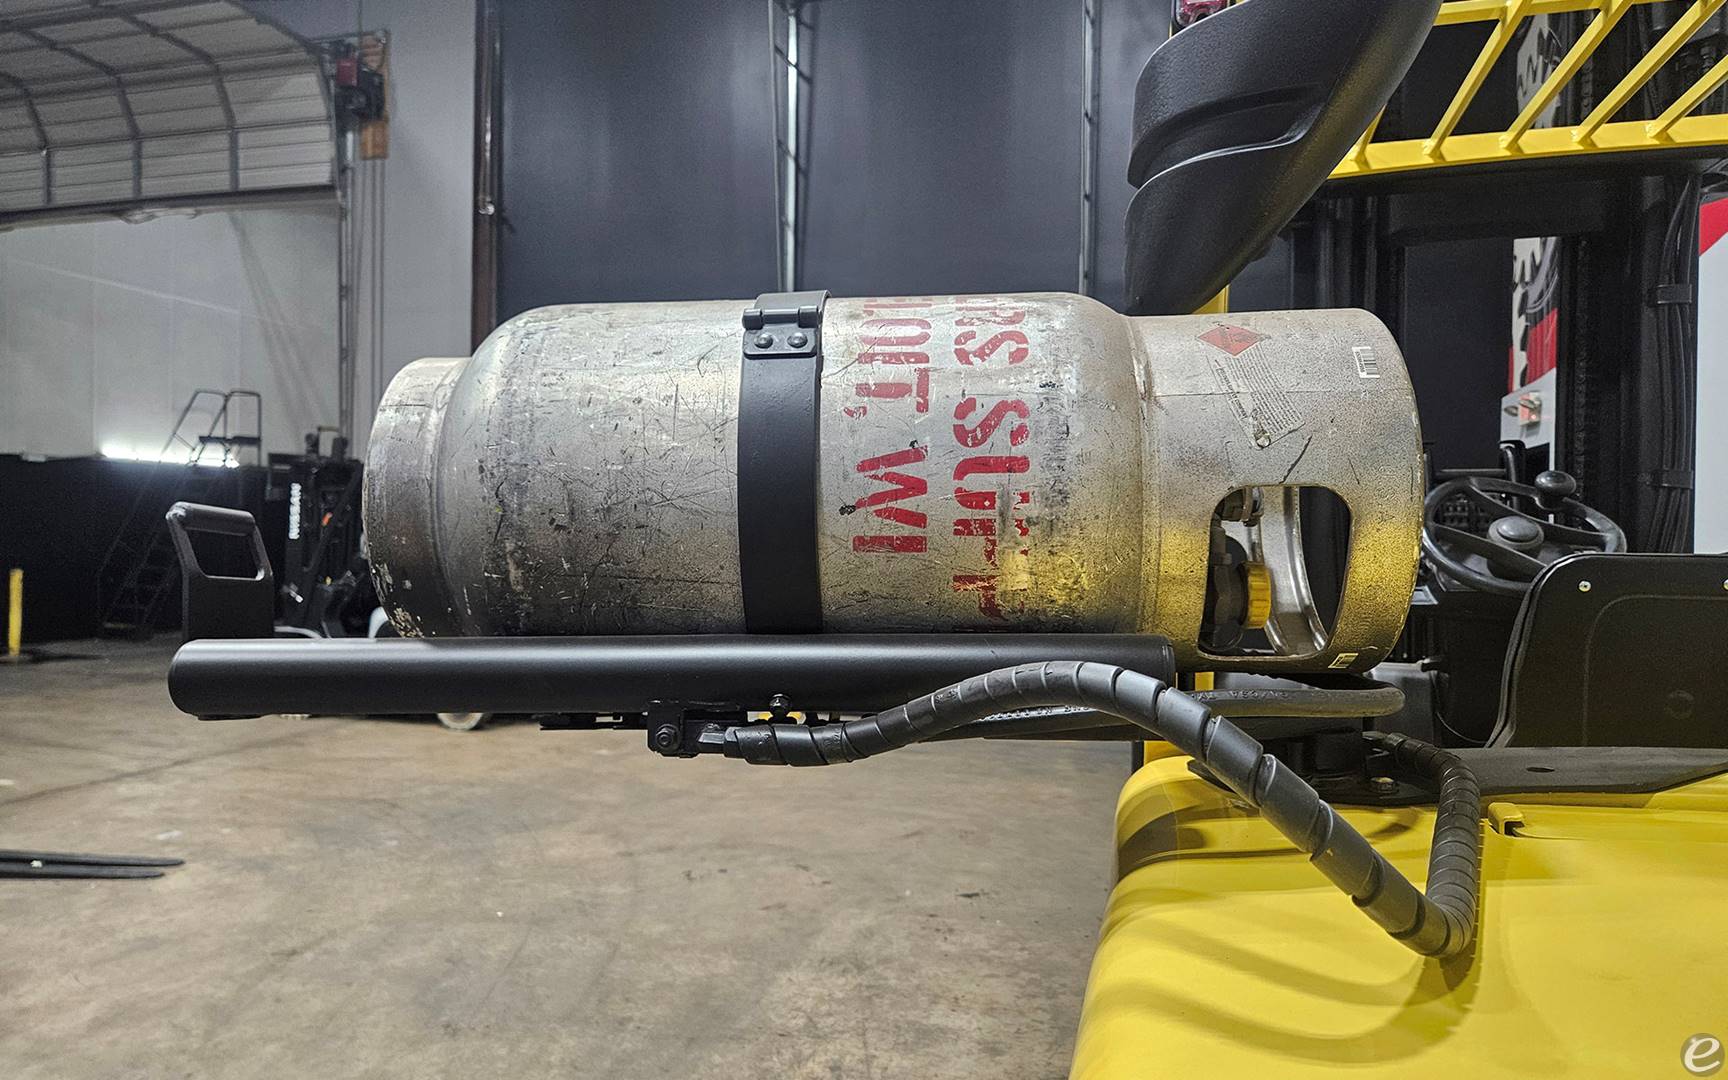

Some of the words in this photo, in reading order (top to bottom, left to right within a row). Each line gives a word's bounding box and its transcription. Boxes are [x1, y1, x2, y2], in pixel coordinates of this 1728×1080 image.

[843, 298, 933, 418] LOIT,
[953, 297, 1030, 366] RS
[852, 444, 929, 553] WI
